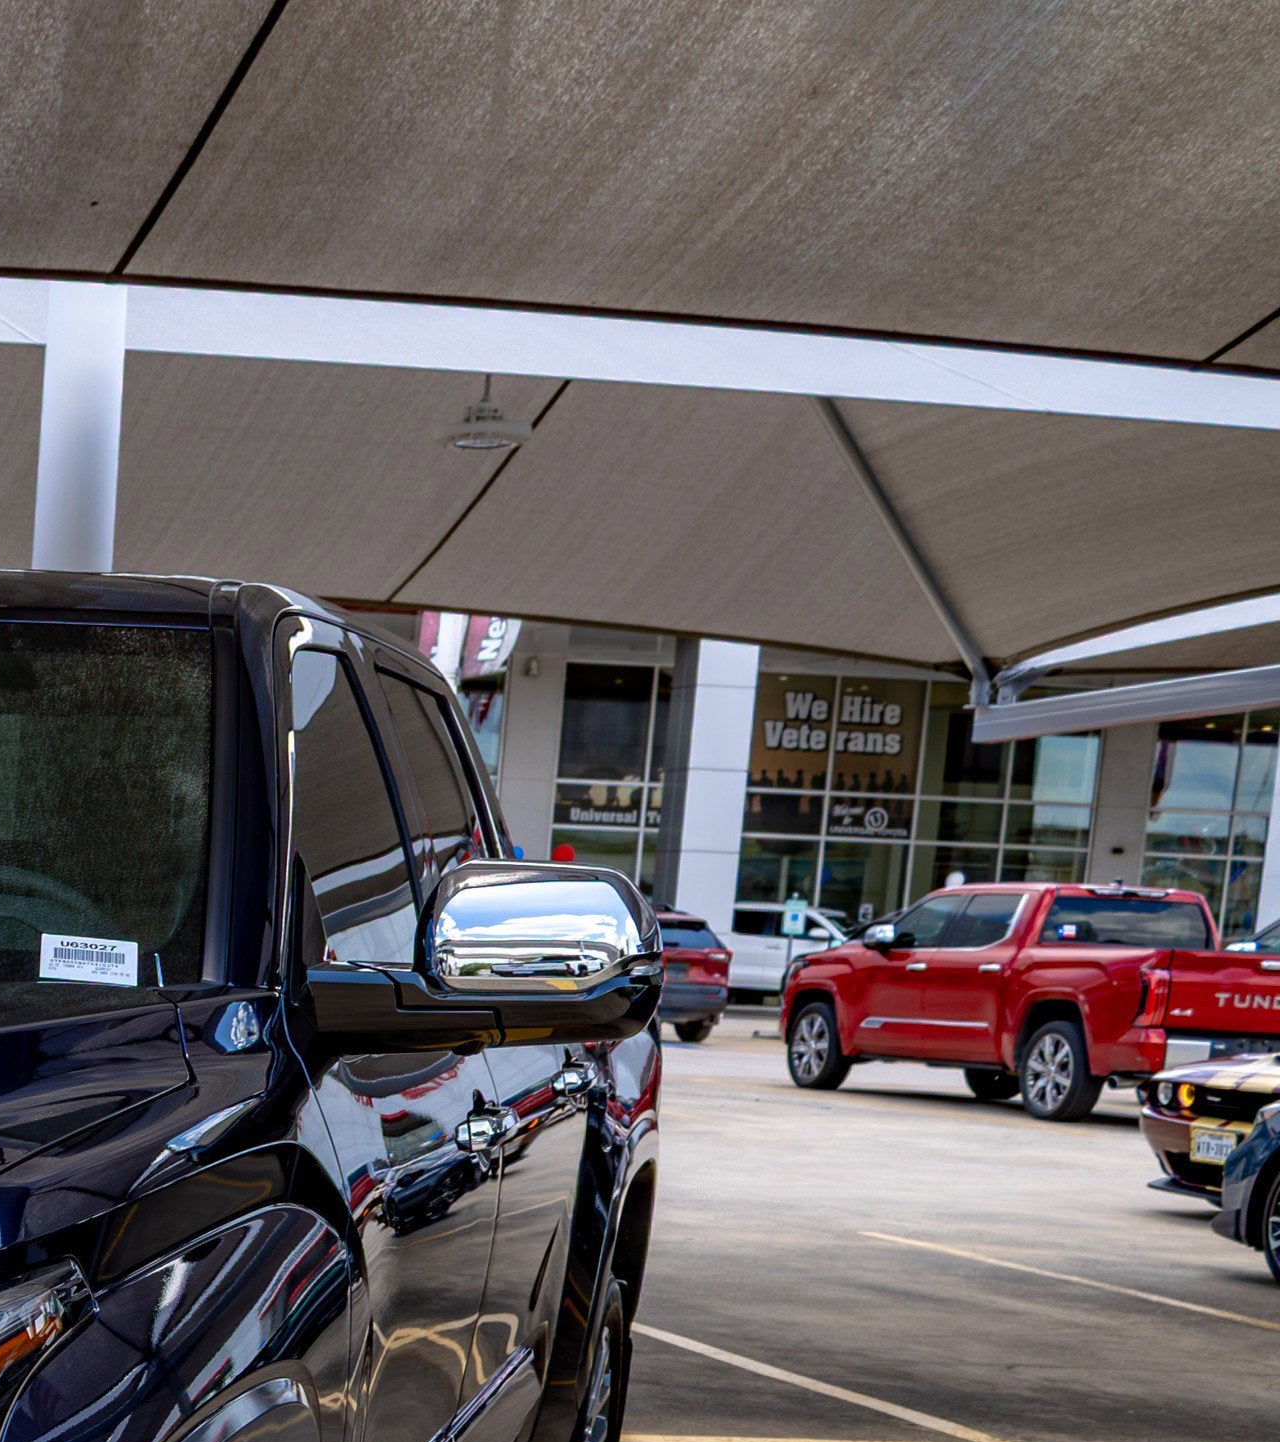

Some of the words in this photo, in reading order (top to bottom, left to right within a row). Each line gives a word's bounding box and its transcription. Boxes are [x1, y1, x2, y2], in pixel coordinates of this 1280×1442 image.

[477, 616, 507, 661] Ne
[785, 691, 829, 720] We
[841, 695, 902, 725] Hire
[765, 720, 902, 754] Veterans
[570, 807, 638, 824] Universal
[60, 940, 118, 952] U63027
